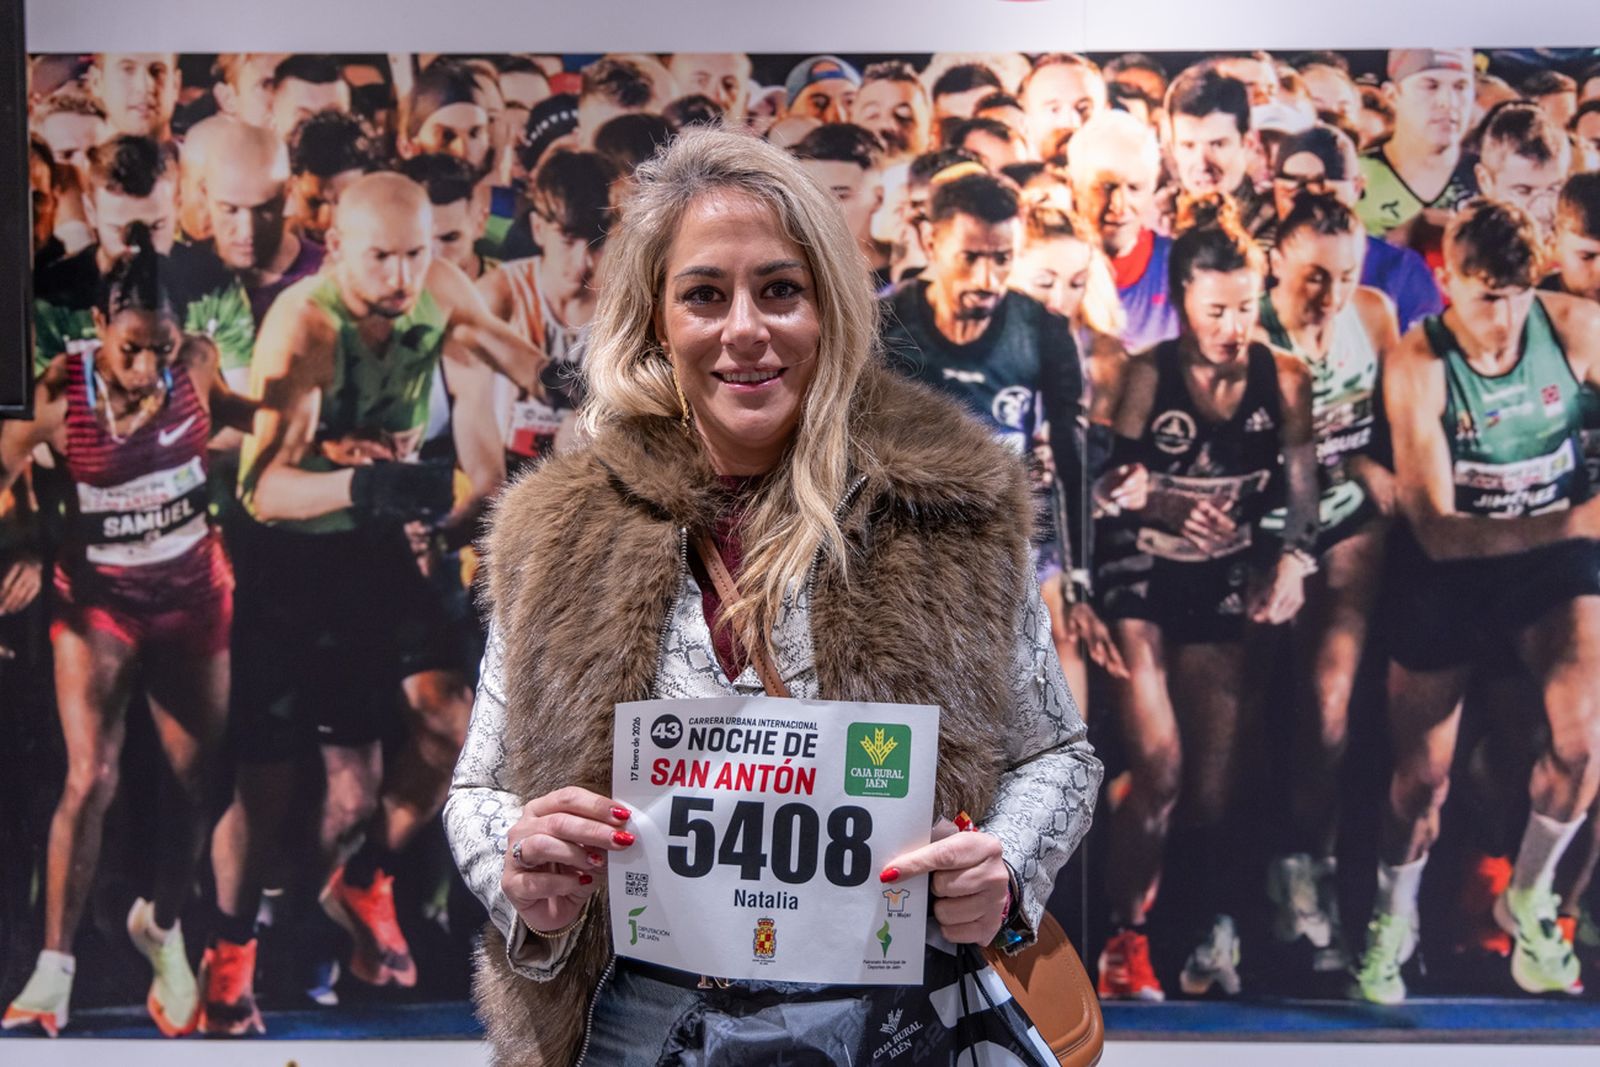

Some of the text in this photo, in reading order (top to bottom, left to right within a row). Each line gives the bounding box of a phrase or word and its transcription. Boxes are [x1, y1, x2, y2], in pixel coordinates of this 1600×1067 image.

[102, 497, 194, 538] SAMUEL
[651, 722, 682, 740] 43
[688, 717, 818, 731] CARRERA URBANA INTERNACIONAL
[630, 716, 641, 782] 17 Enero de 2026
[687, 727, 818, 759] NOCHE DE
[650, 757, 817, 796] SAN ANTÓN
[850, 767, 904, 779] CAJA RURAL
[865, 777, 889, 788] JAÉN
[667, 795, 873, 888] 5408
[733, 889, 799, 910] Natalia
[872, 1020, 923, 1060] CAJA RURAL
[888, 1038, 913, 1060] JAÉN
